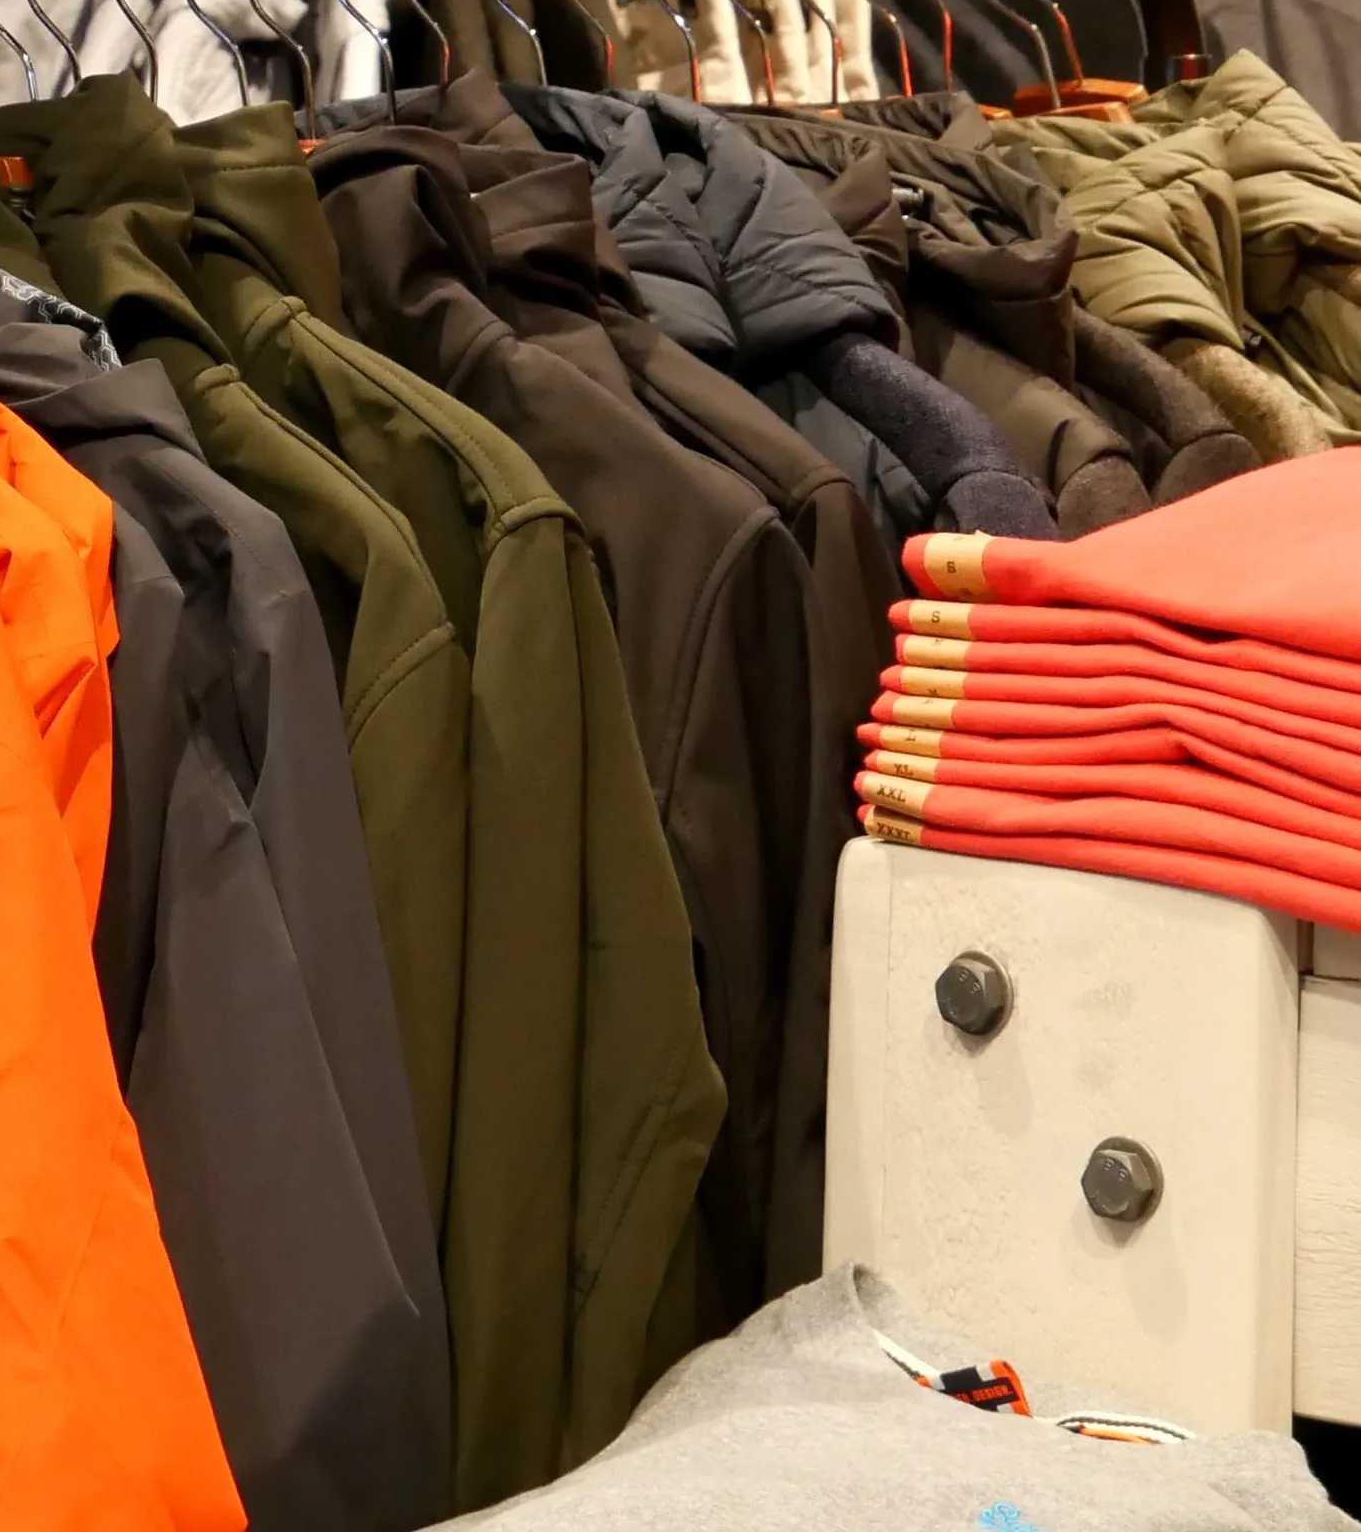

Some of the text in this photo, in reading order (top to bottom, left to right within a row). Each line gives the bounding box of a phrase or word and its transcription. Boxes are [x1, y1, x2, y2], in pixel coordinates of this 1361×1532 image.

[930, 610, 941, 624] S
[876, 783, 907, 804] XXL
[876, 822, 914, 843] XXXL
